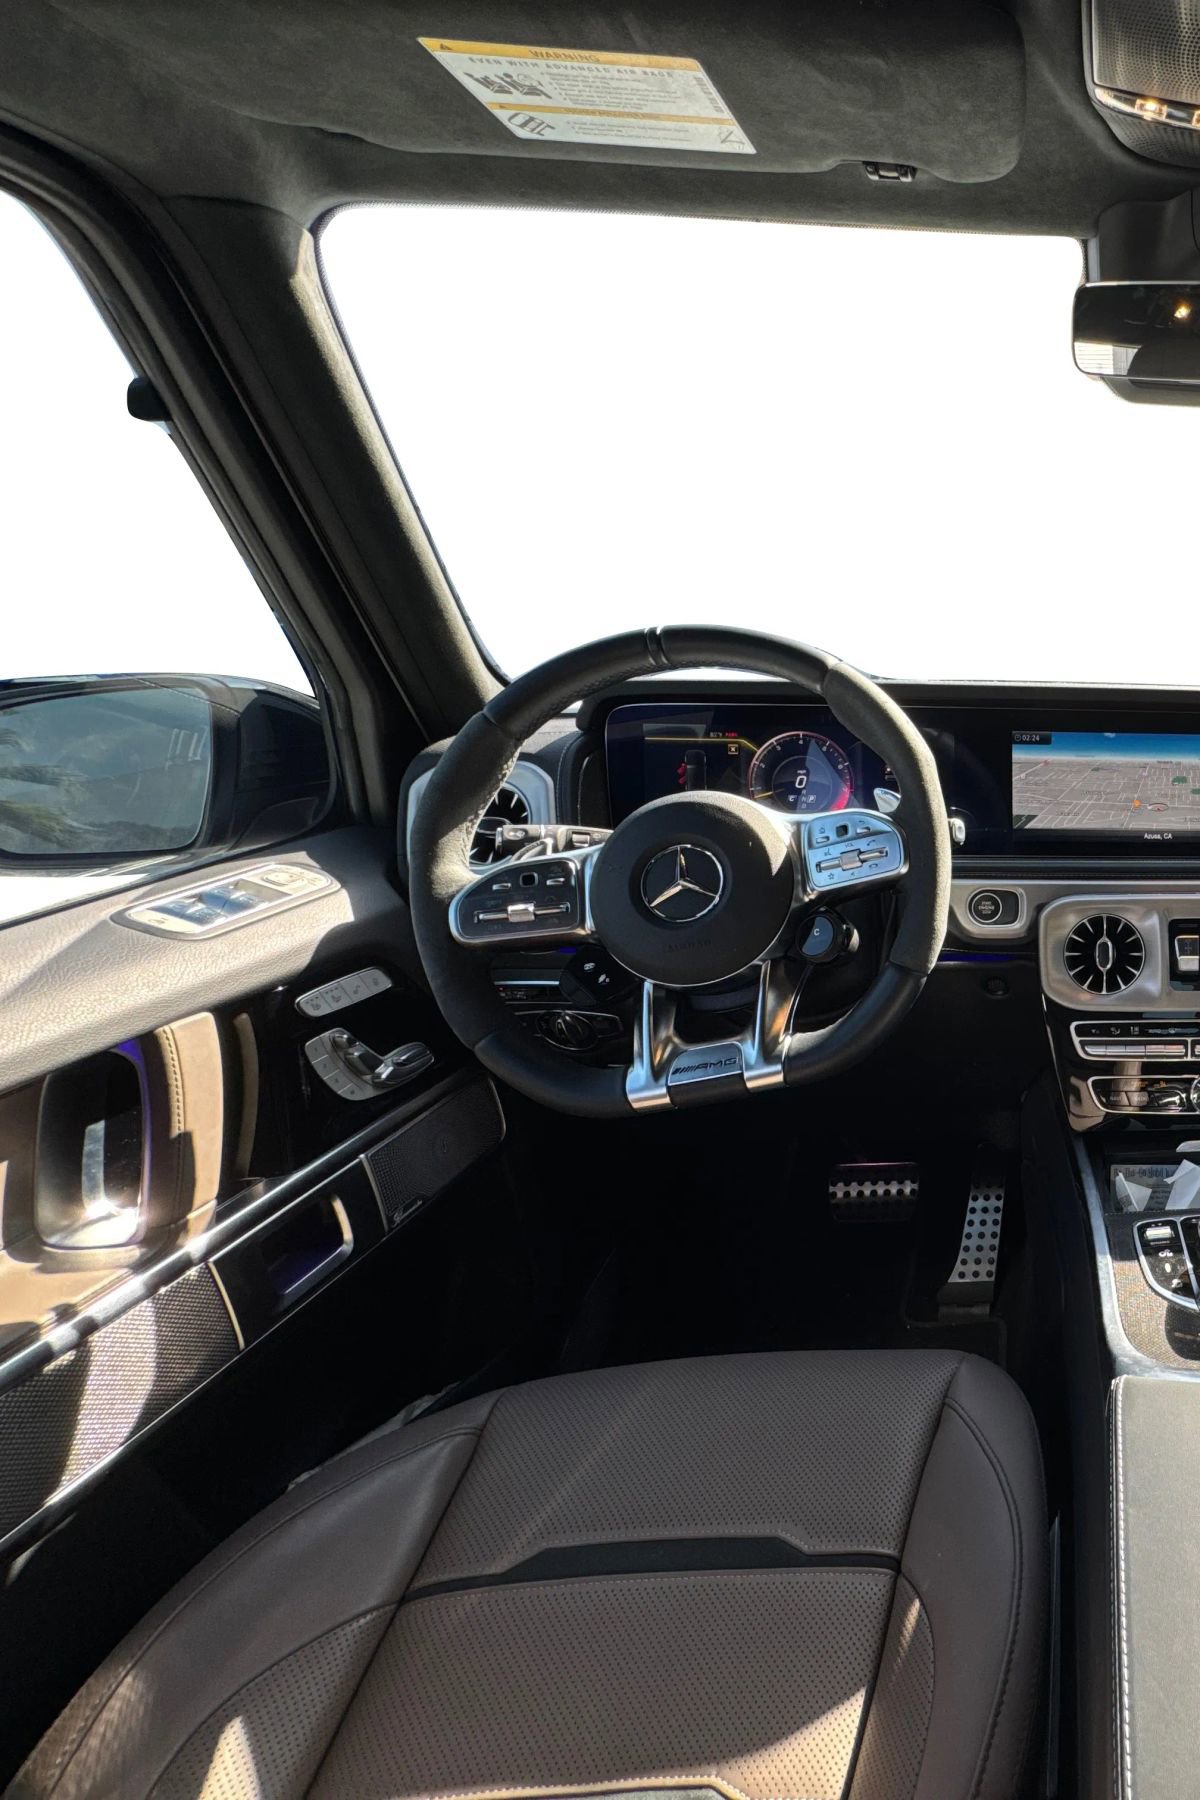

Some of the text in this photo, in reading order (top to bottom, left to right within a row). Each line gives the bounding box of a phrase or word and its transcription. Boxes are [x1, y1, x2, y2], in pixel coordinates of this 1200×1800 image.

[529, 49, 599, 63] WARNING
[1022, 734, 1040, 742] 02:24
[795, 775, 807, 788] 0
[1164, 832, 1173, 840] CA
[813, 928, 820, 936] C
[695, 1057, 737, 1071] AMG
